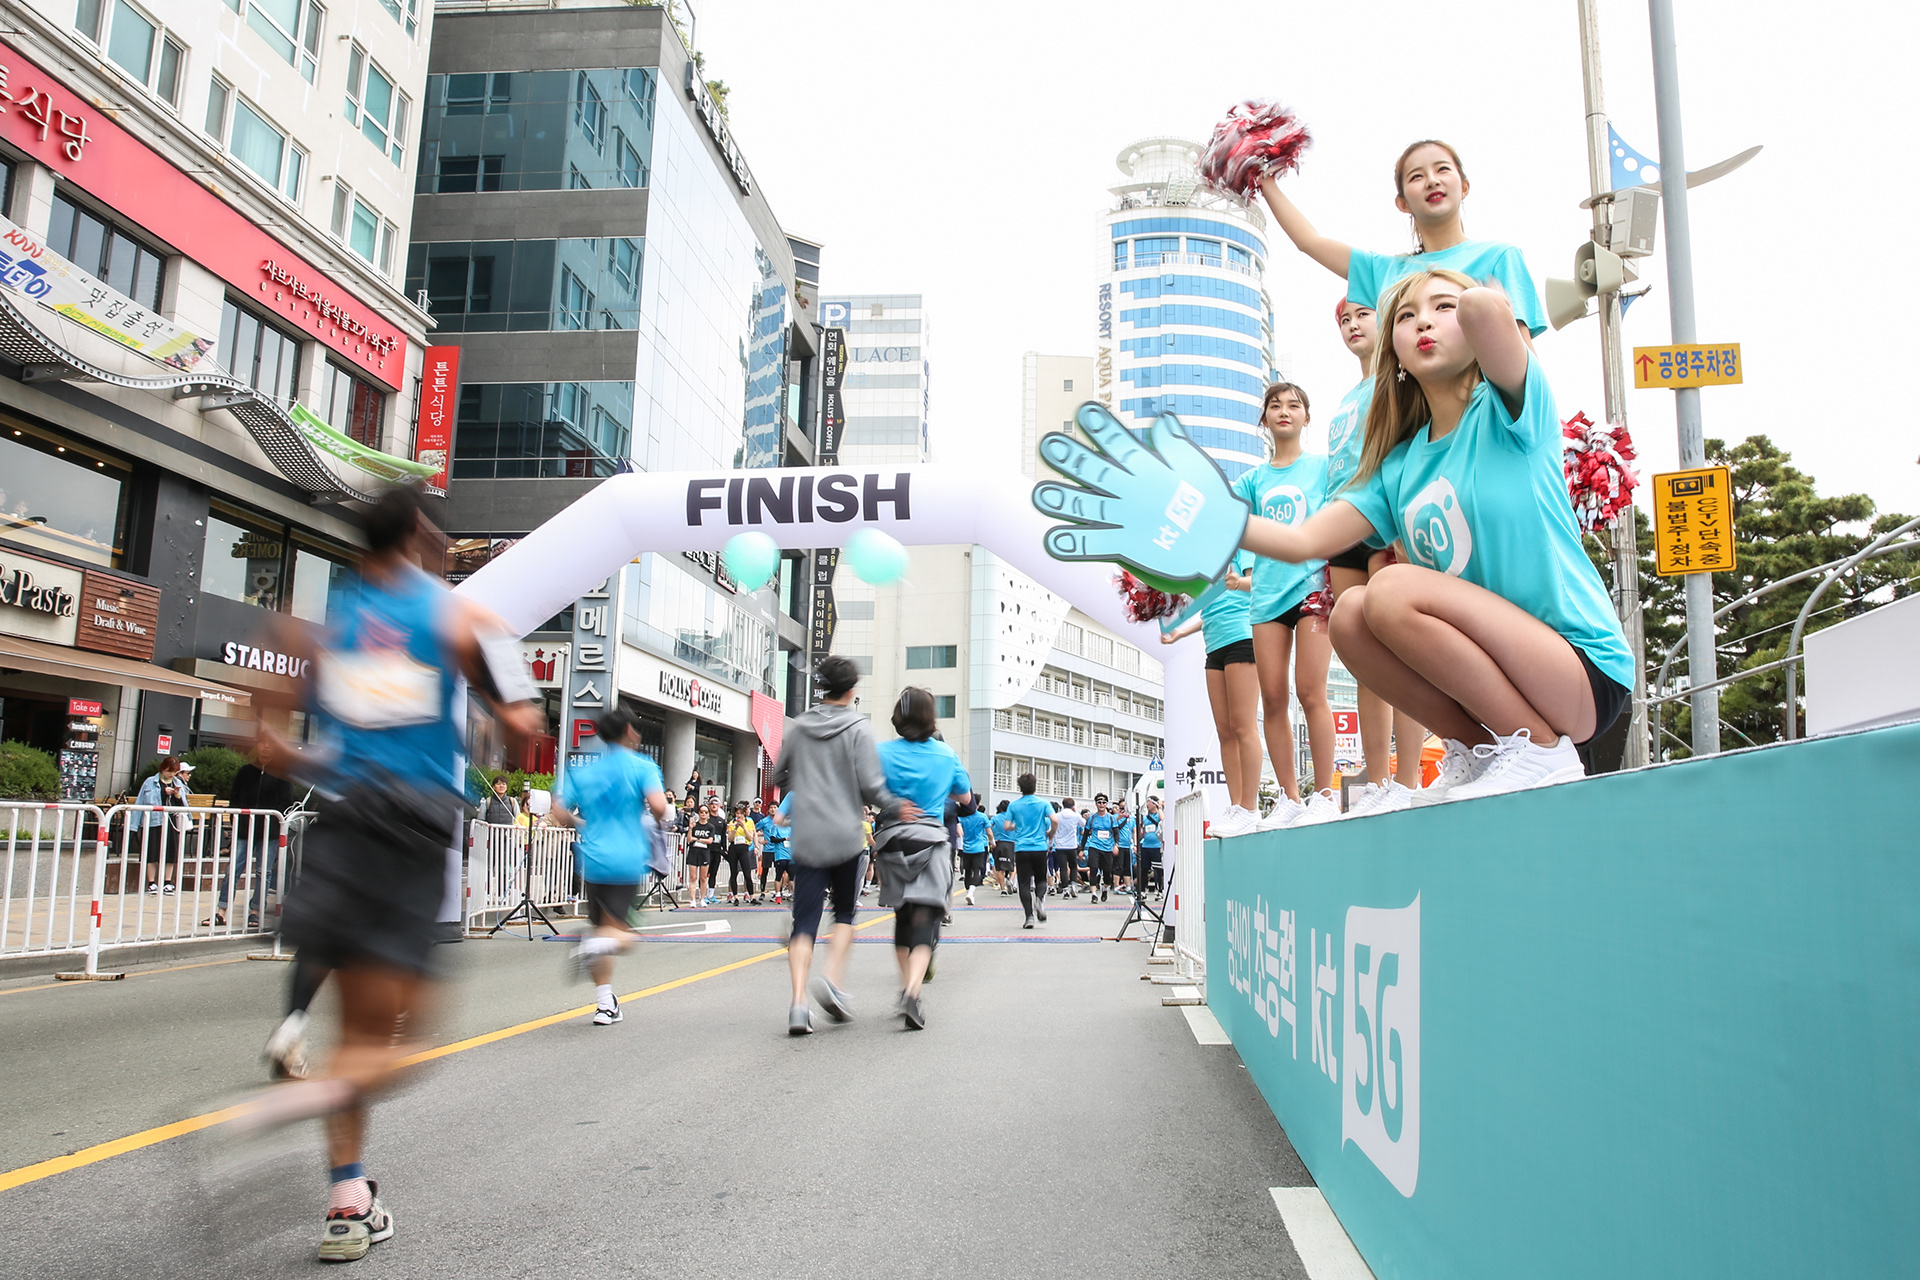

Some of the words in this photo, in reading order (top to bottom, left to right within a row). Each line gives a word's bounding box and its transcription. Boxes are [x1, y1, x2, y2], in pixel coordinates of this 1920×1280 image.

[1099, 283, 1112, 340] RESORT
[1096, 345, 1112, 389] AQUA
[1659, 349, 1736, 379] 공영주차장
[430, 361, 449, 427] 튼튼식당
[825, 426, 833, 450] COFFEE
[686, 473, 911, 526] FINISH
[1265, 503, 1292, 522] 360
[1151, 524, 1181, 552] kt
[1415, 517, 1449, 553] 30
[1665, 500, 1693, 568] 불법주·정차
[1697, 497, 1722, 566] CCTV단속중
[13, 569, 76, 618] Pasta
[95, 598, 120, 613] Music
[94, 614, 115, 630] Draft
[116, 619, 124, 631] &
[125, 621, 147, 636] Wine
[72, 701, 87, 713] Take
[89, 705, 100, 713] out
[659, 671, 692, 703] HOLLYS
[699, 686, 722, 713] COFFE
[571, 718, 599, 748] P
[1337, 714, 1349, 731] 5
[1334, 737, 1356, 747] UTI
[694, 829, 710, 837] BRC
[1226, 899, 1251, 1006] 당신의
[1253, 893, 1297, 1062] 초능력
[1311, 927, 1337, 1085] kt
[1354, 941, 1404, 1144] 5G
